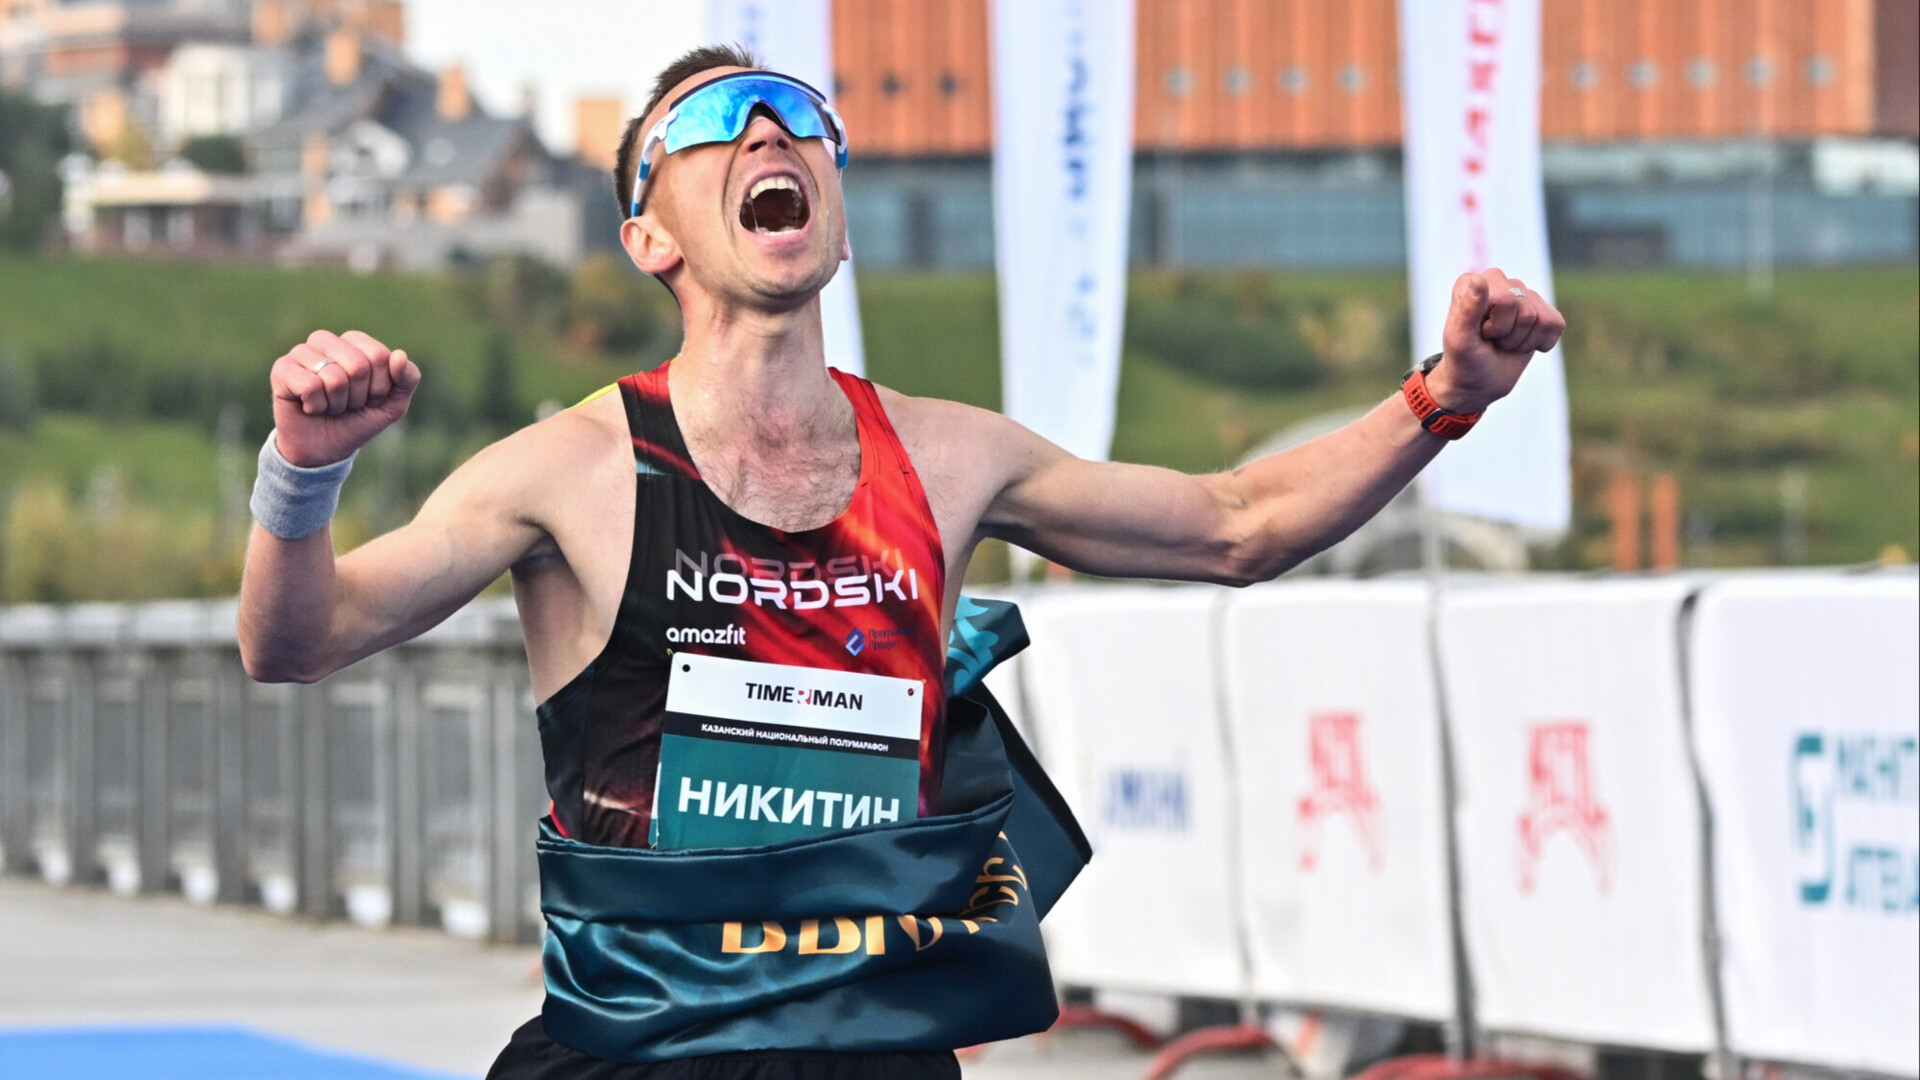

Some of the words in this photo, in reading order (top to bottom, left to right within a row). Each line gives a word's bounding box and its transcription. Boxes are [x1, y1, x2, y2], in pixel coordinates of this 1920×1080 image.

[666, 568, 919, 611] NORDSKI
[666, 623, 746, 646] amazfit
[701, 723, 755, 738] КАЗАНСКИЙ
[755, 731, 829, 746] НАЦИОНАЛЬНЫЙ
[829, 737, 889, 752] ПОЛУМАРАФОН
[678, 776, 900, 830] НИКИТИН
